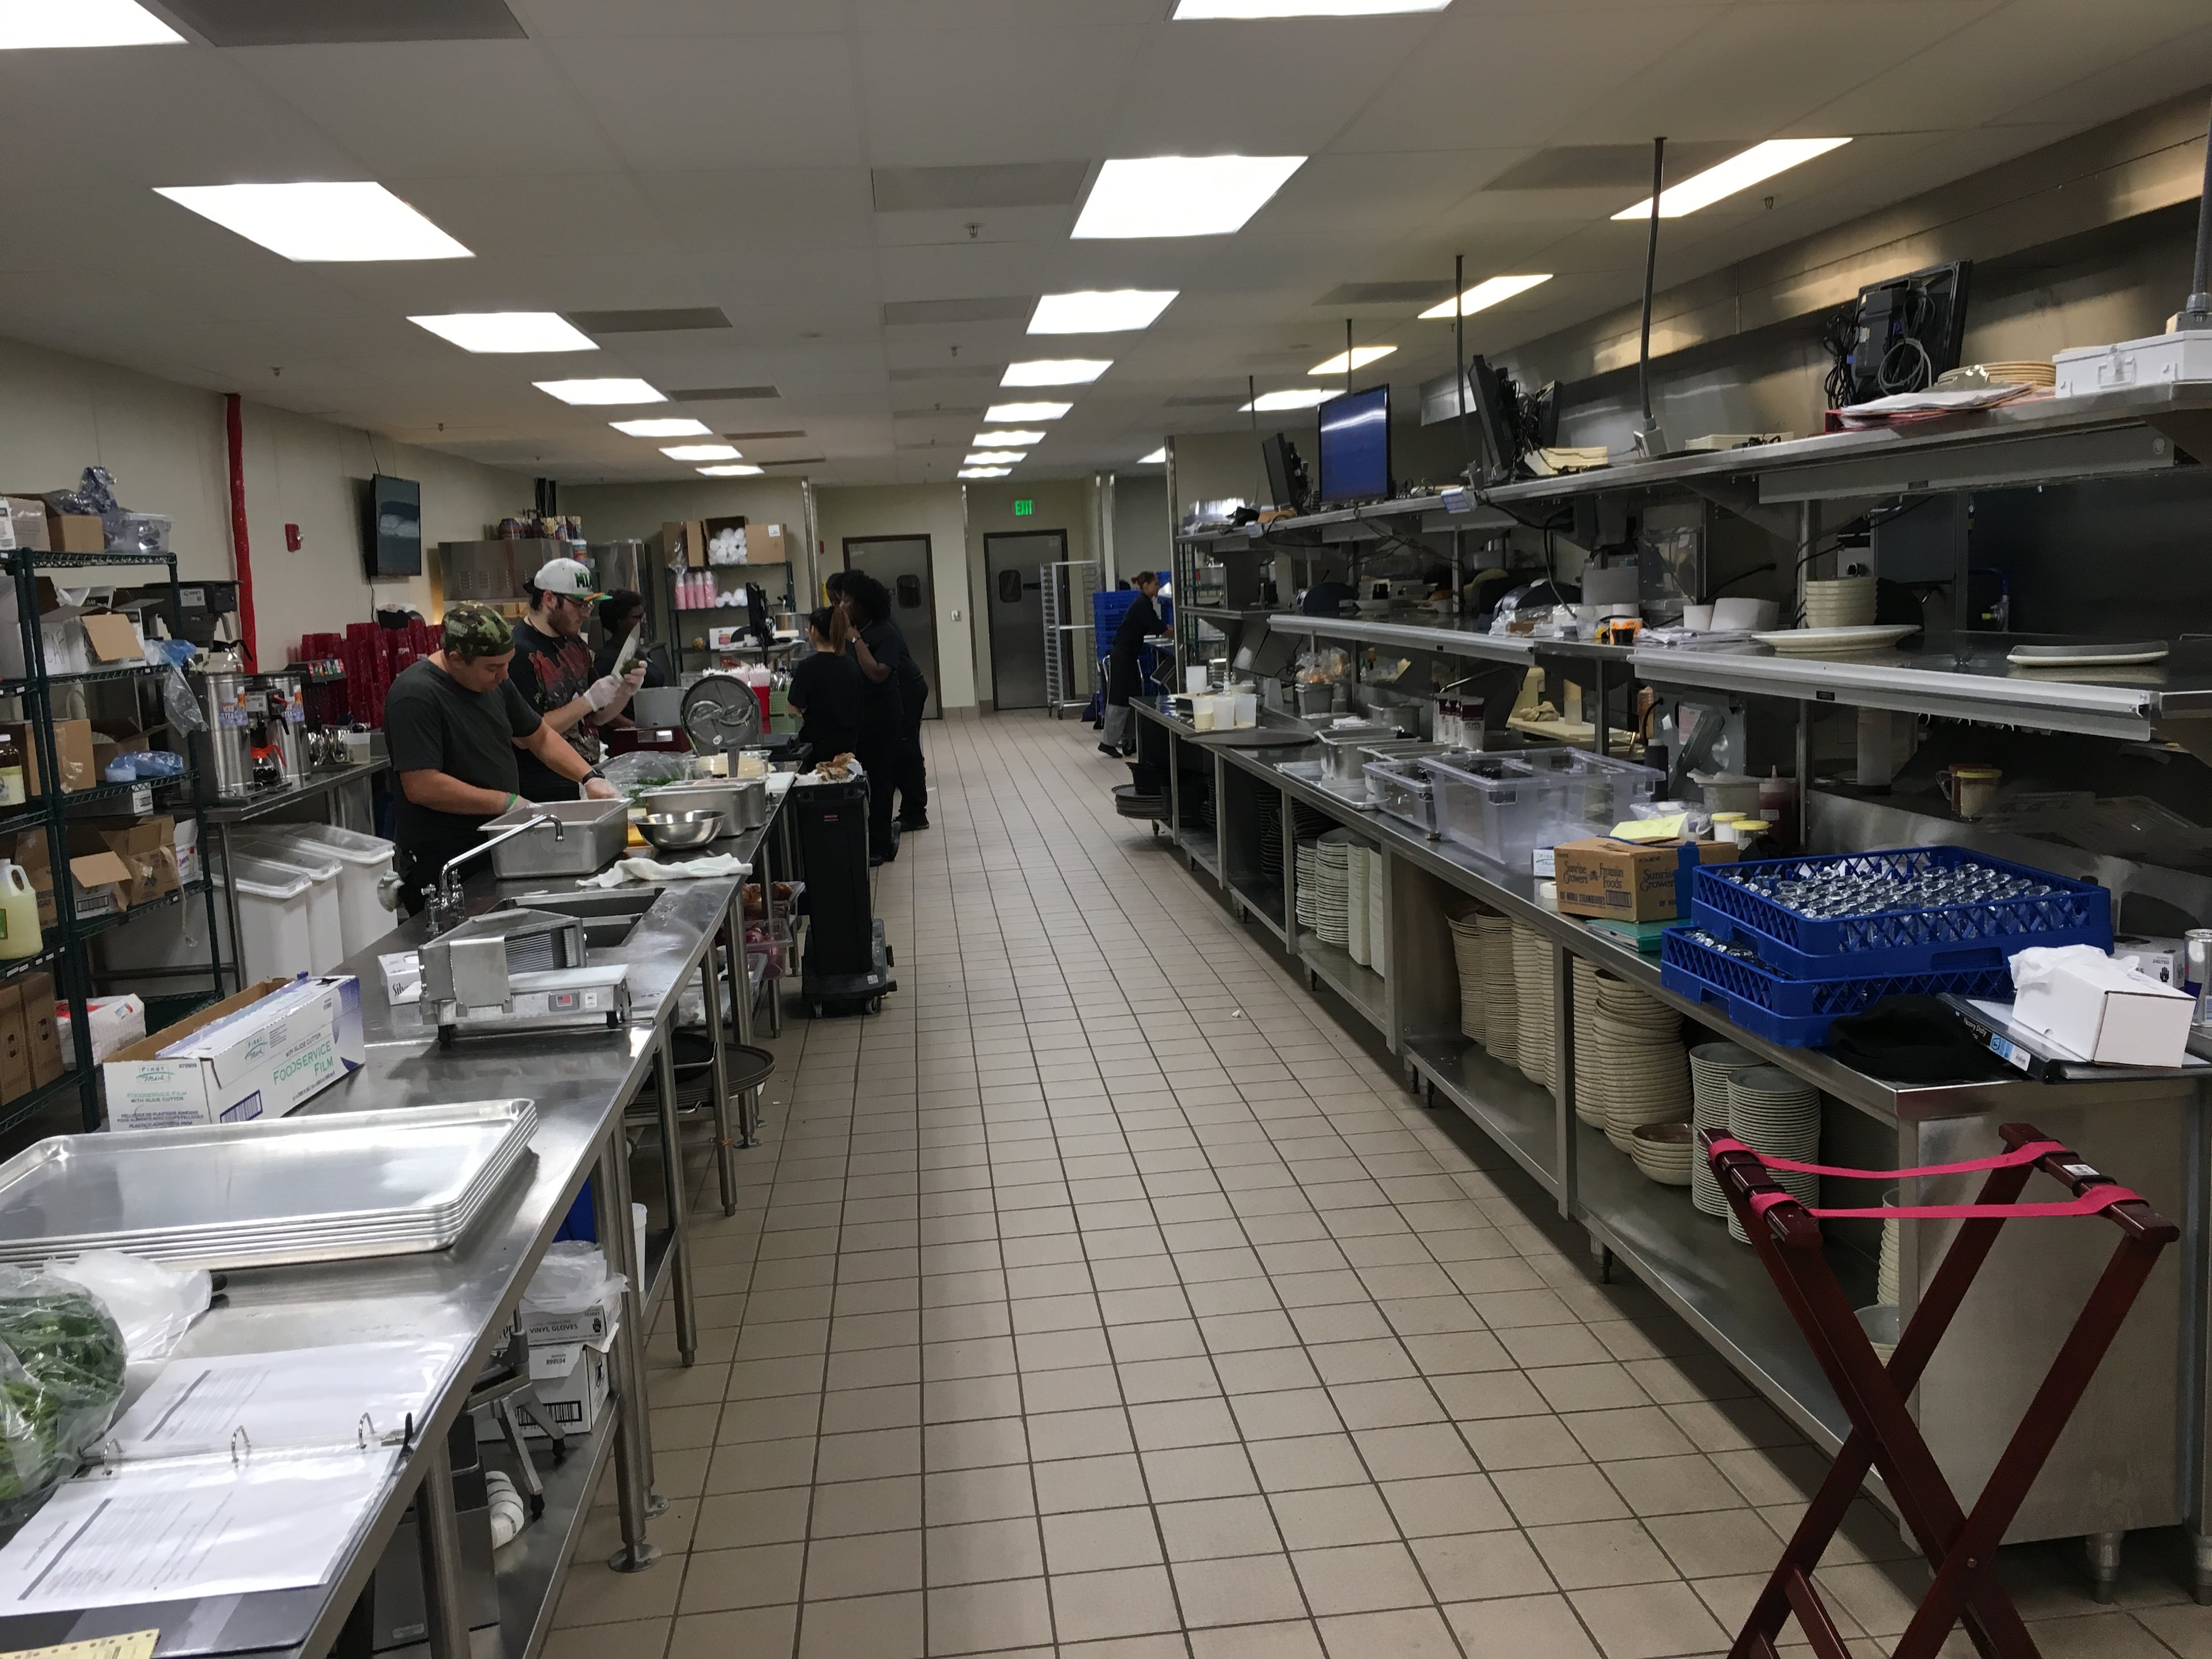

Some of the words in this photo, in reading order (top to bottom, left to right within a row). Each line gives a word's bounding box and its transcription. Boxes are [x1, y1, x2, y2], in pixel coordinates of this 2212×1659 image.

[1015, 499, 1032, 516] EXIT
[1565, 860, 1587, 874] Sunrise
[1563, 872, 1588, 884] Growers
[1643, 869, 1673, 881] Sunris
[1603, 876, 1622, 889] Foods
[1639, 880, 1675, 892] Grower
[1976, 1025, 1987, 1037] Duty
[248, 1036, 262, 1048] FIRST
[294, 1041, 306, 1053] SLIDE
[306, 1032, 321, 1045] CUTTER
[273, 1040, 332, 1085] FOODSERVICE
[314, 1056, 334, 1076] FILM
[142, 1074, 165, 1082] Mark
[529, 1325, 550, 1334] VINYL
[551, 1323, 578, 1332] GLOVES
